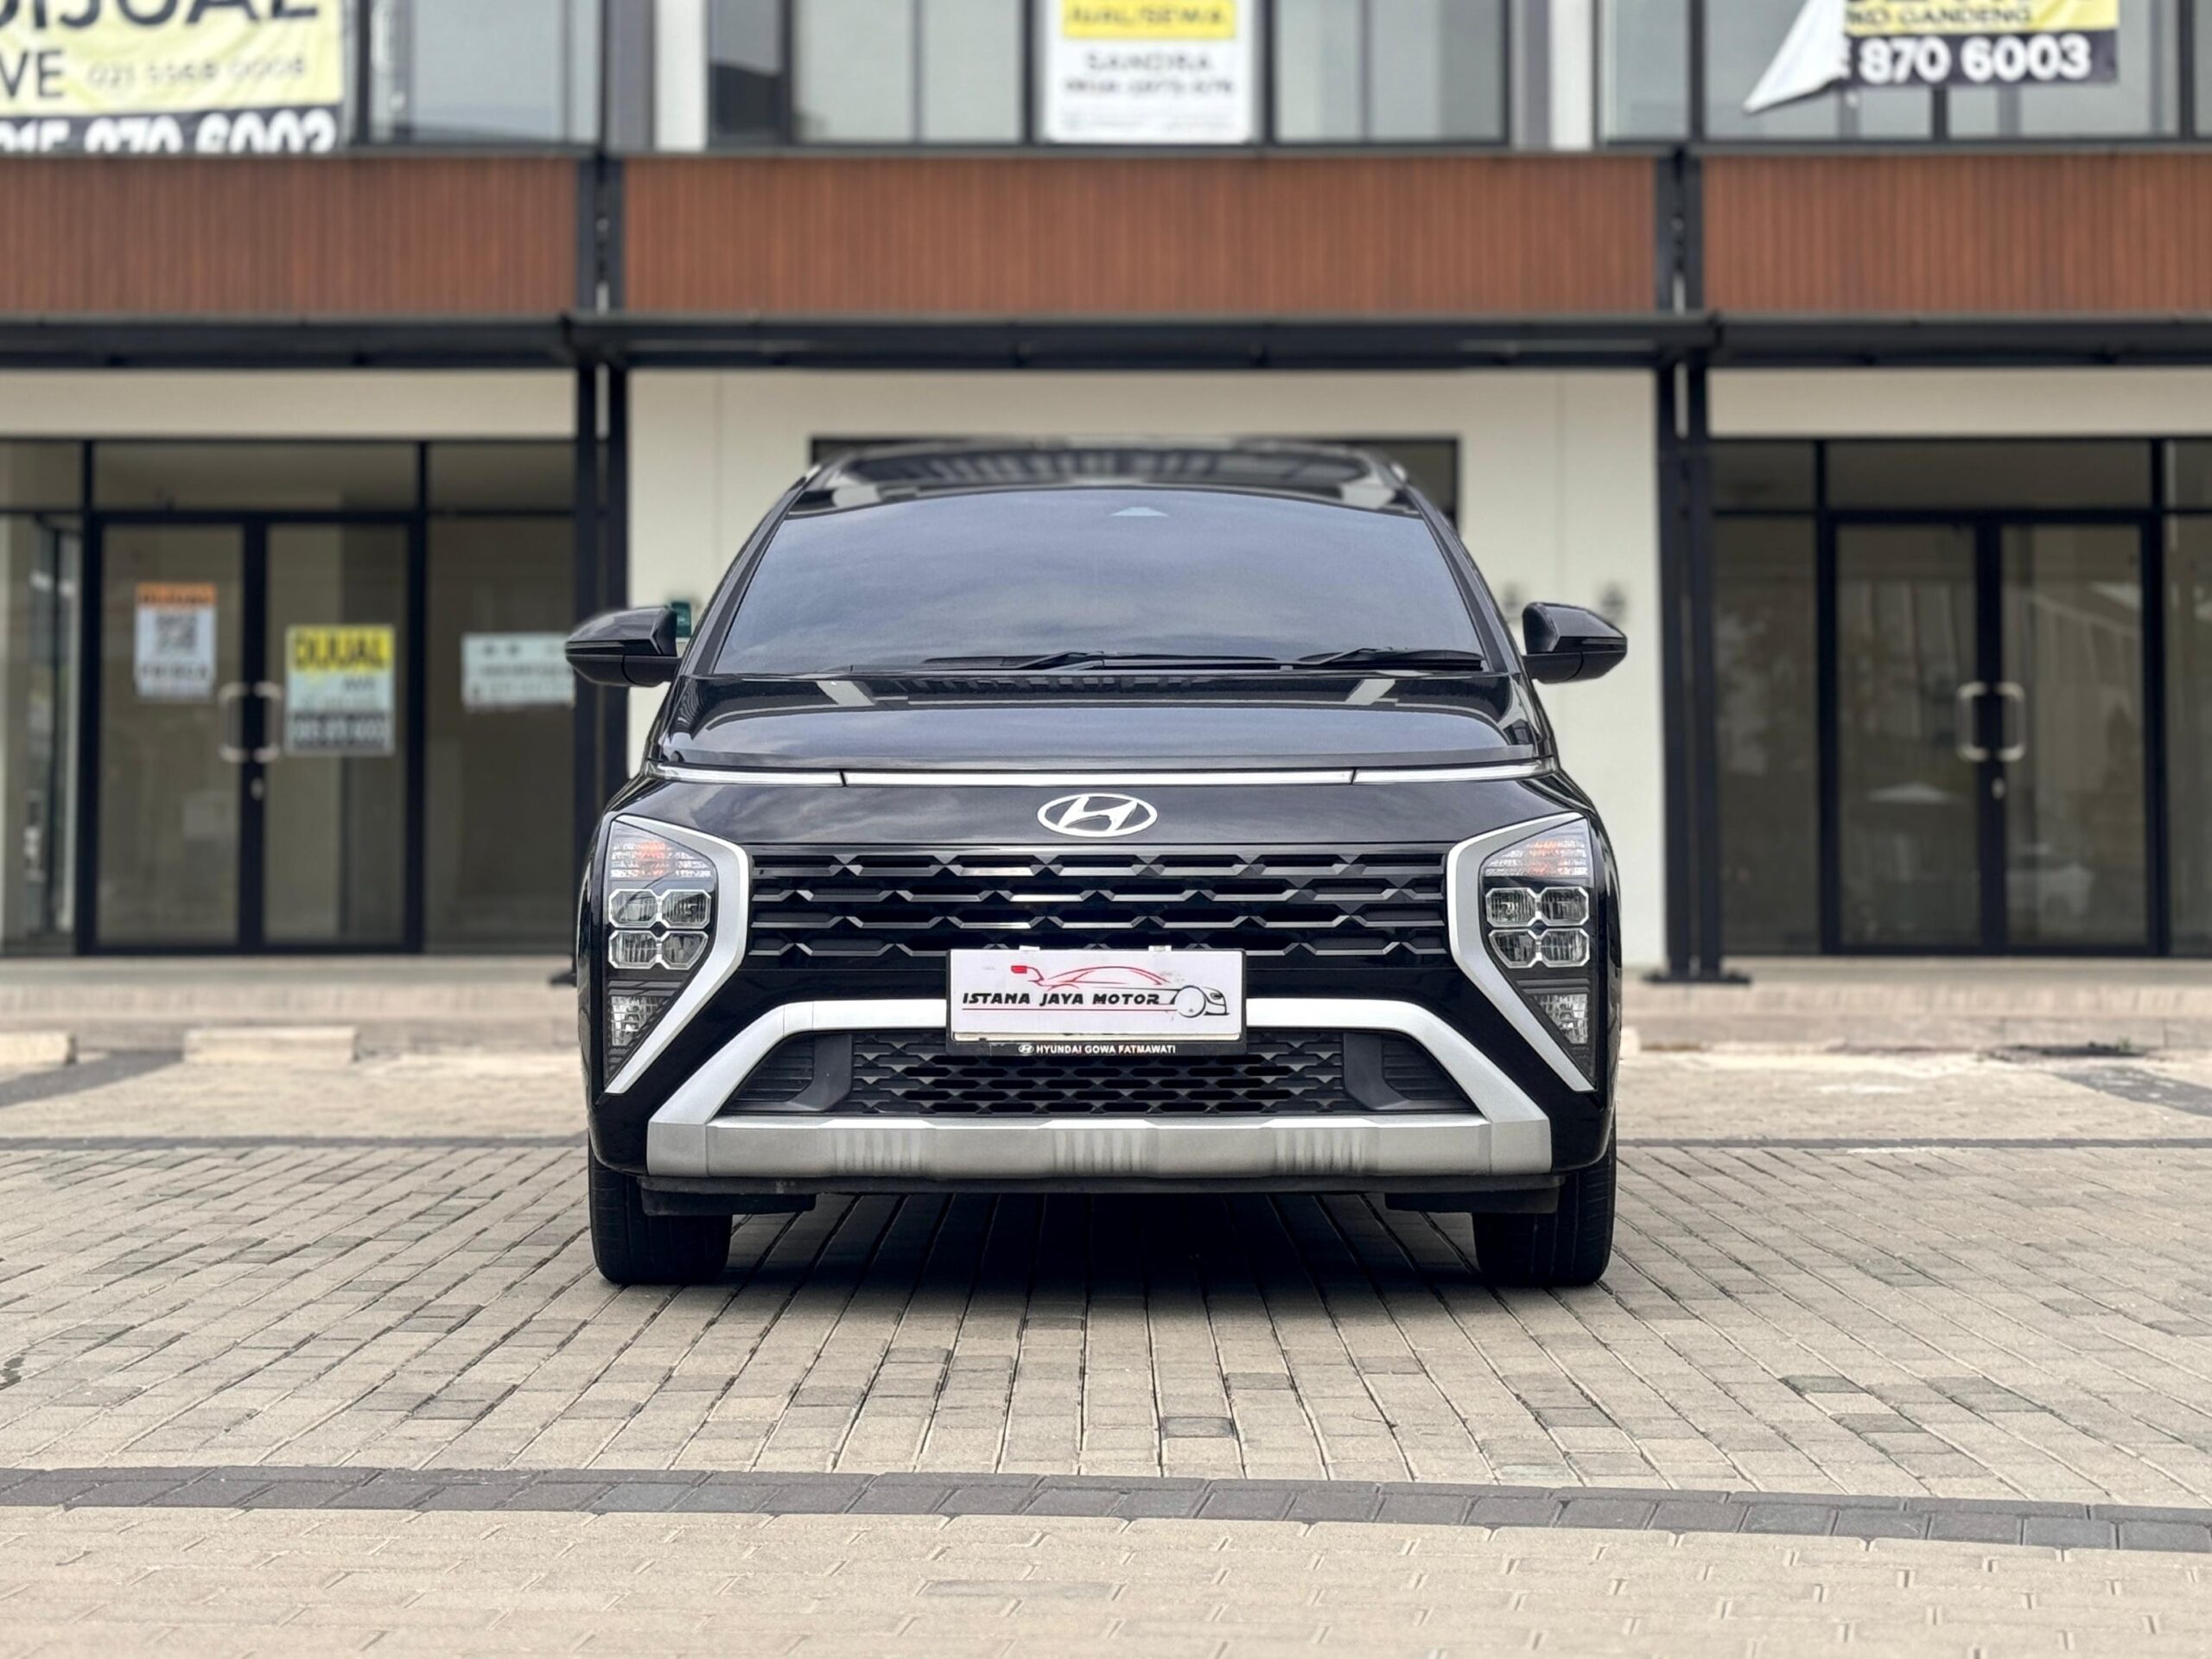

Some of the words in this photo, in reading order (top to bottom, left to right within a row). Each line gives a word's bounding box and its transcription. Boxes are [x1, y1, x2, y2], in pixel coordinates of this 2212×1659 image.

[1859, 35, 1952, 84] 870
[1960, 32, 2092, 82] 6003
[962, 992, 1031, 1005] ISTANA
[1039, 992, 1084, 1007] JAYA
[1092, 993, 1160, 1005] MOTOR
[1037, 1045, 1081, 1054] HYUNDAI
[1084, 1045, 1116, 1053] GOWA
[1118, 1044, 1176, 1053] FATMAWATI
